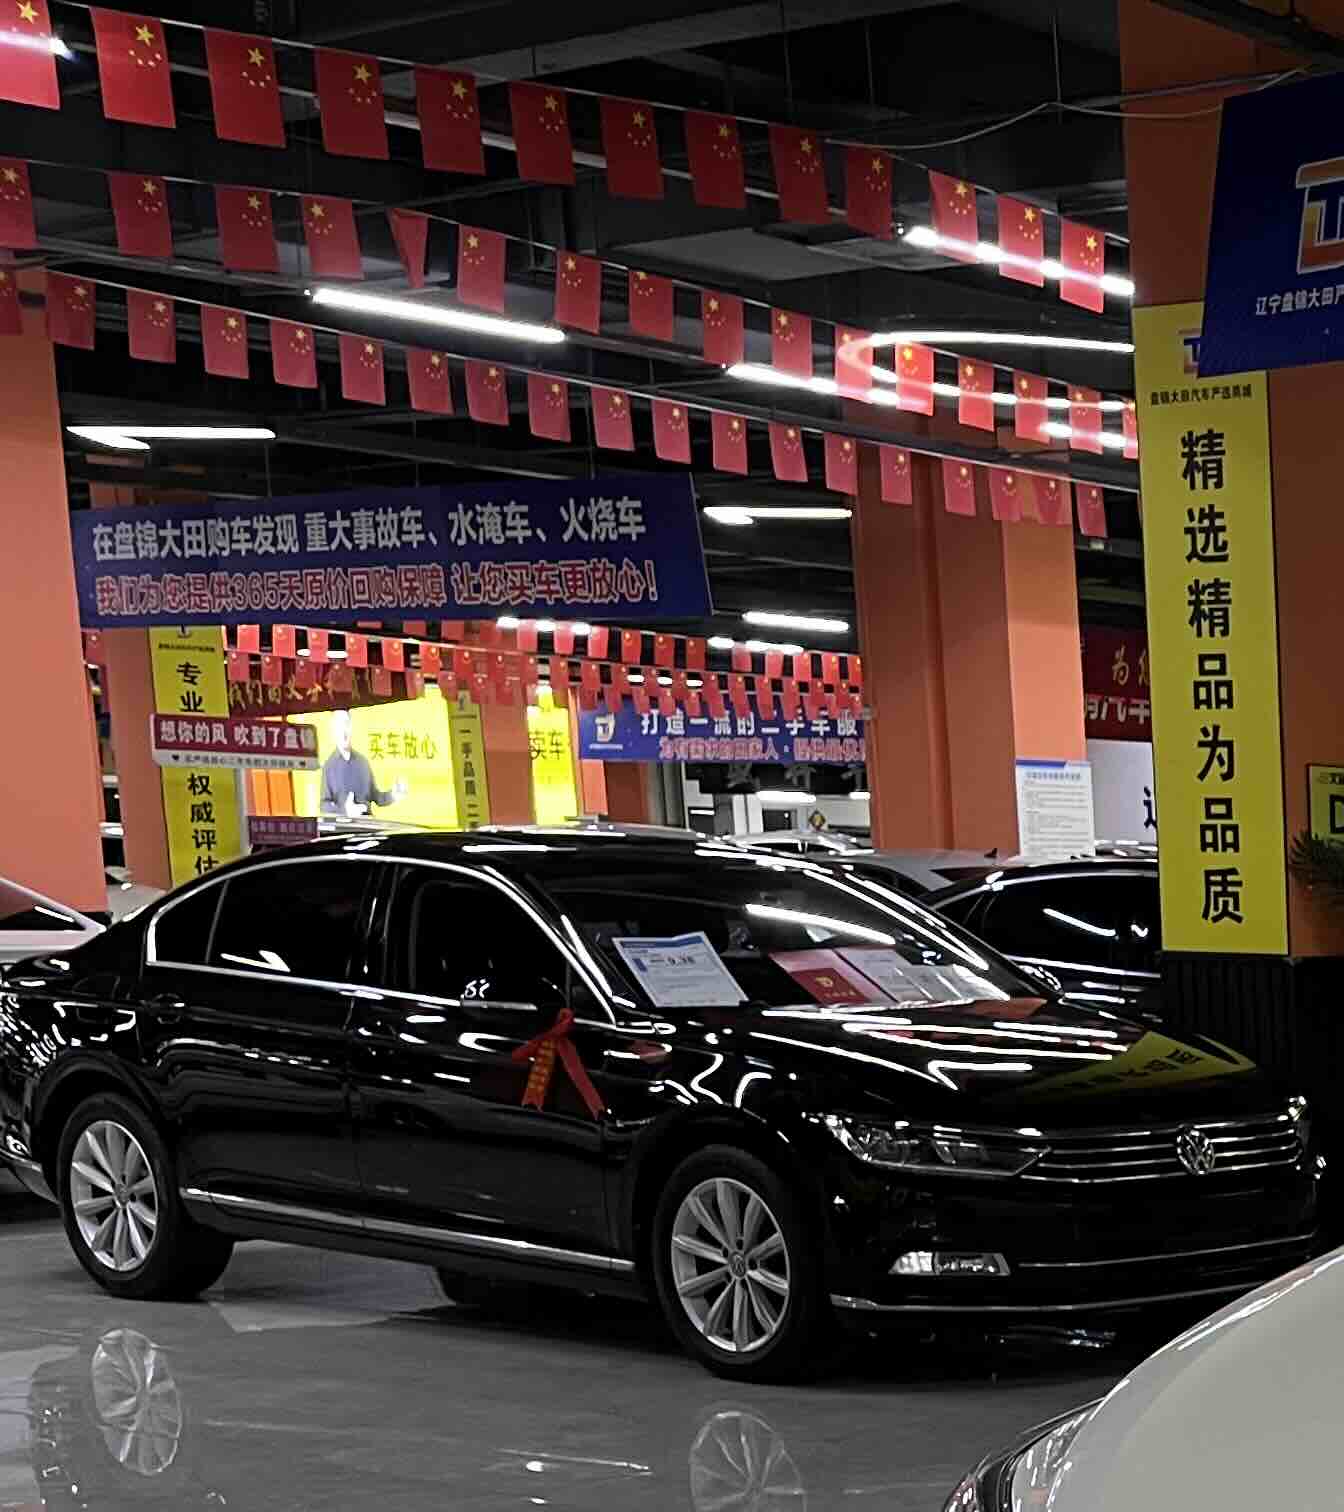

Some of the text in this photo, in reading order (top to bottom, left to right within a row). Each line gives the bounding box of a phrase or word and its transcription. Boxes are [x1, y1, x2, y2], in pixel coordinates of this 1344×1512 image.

[93, 514, 300, 561] 在盘锦大田购车发现
[96, 564, 447, 616] 我们为您提供365天原价回购保障
[176, 661, 205, 713] 专业
[1180, 428, 1245, 926] 精选精品为品质
